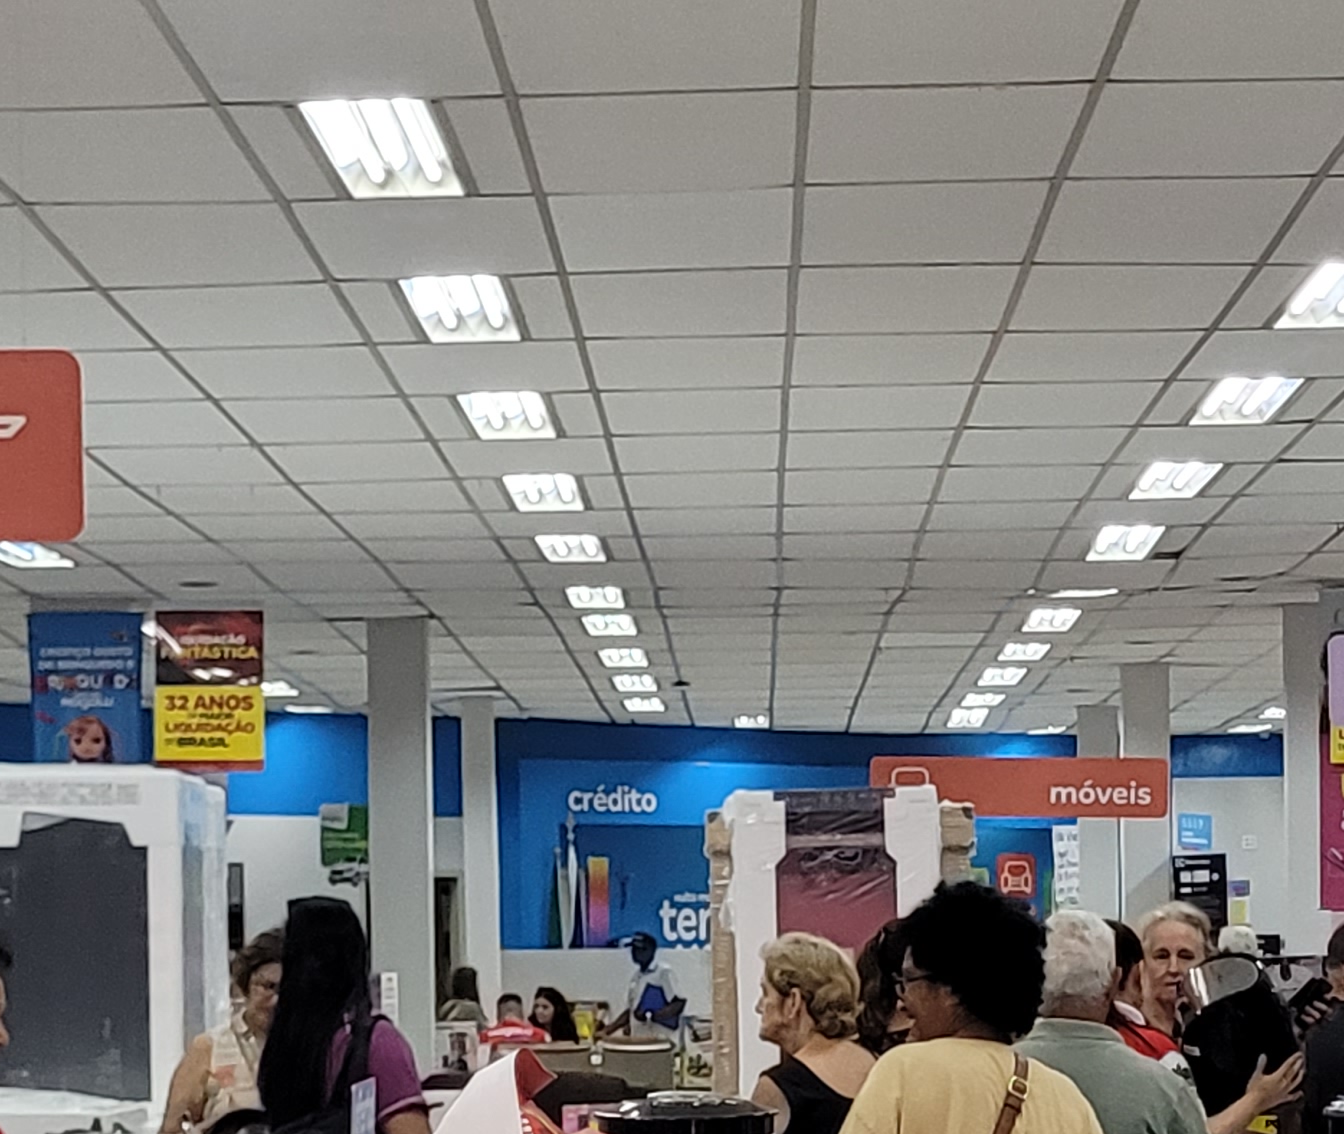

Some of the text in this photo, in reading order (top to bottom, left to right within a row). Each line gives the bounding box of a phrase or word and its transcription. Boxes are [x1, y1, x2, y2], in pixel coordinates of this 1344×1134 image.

[164, 694, 255, 712] 32 ANOS
[567, 783, 658, 813] crédito
[1048, 779, 1153, 806] móveis
